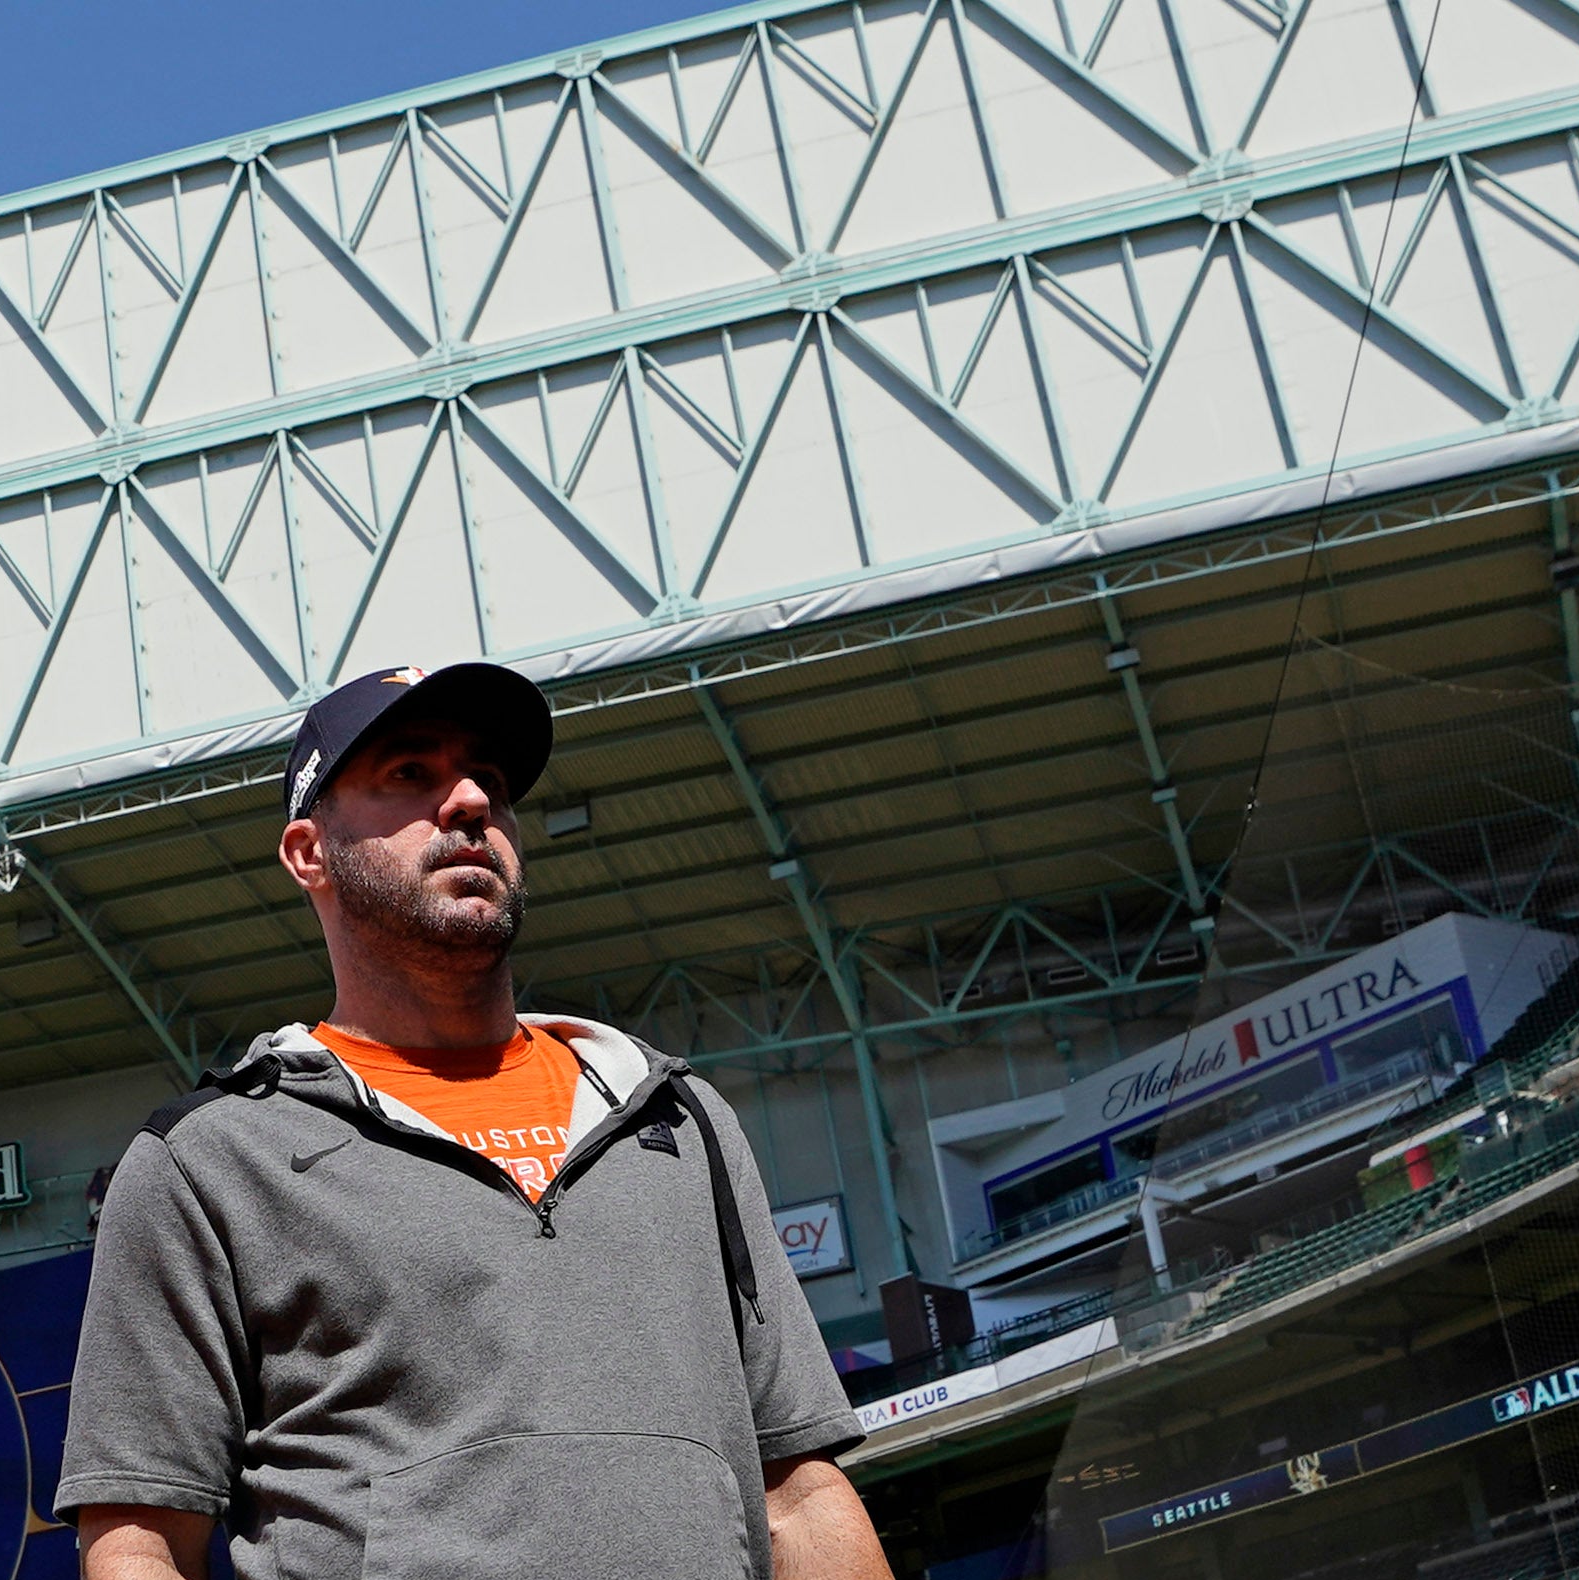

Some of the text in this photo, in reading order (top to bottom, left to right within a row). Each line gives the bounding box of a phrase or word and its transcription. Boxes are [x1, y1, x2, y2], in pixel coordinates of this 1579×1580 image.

[1101, 957, 1422, 1121] Michelob ULTRA
[453, 1125, 569, 1152] USTON
[902, 1386, 949, 1413] CLUB
[1151, 1491, 1233, 1528] SEATTLE
